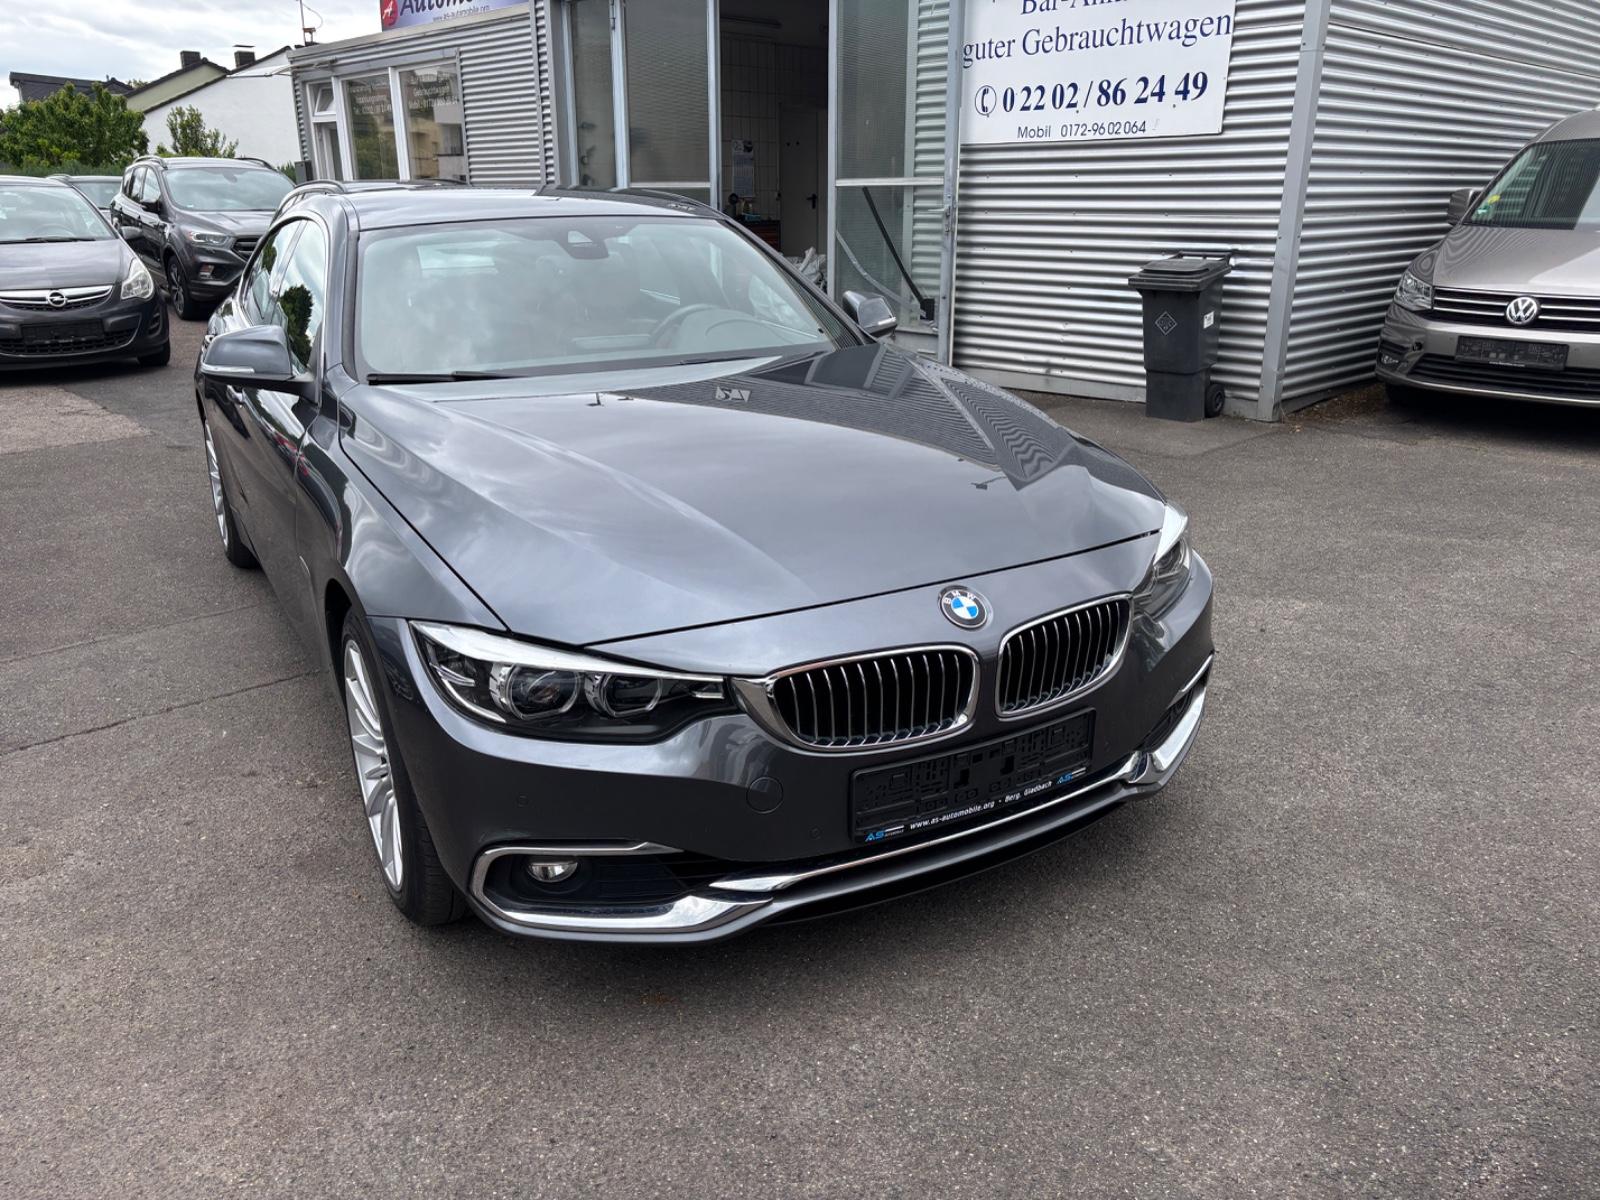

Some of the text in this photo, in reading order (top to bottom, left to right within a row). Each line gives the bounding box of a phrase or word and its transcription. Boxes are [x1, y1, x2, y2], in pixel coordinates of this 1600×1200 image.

[400, 0, 473, 16] Autom
[962, 14, 1231, 69] guter Gebrauchtwagen
[1017, 125, 1051, 139] Mobil
[909, 800, 996, 830] www.as-automobile.org
[1023, 780, 1053, 796] Gladbach
